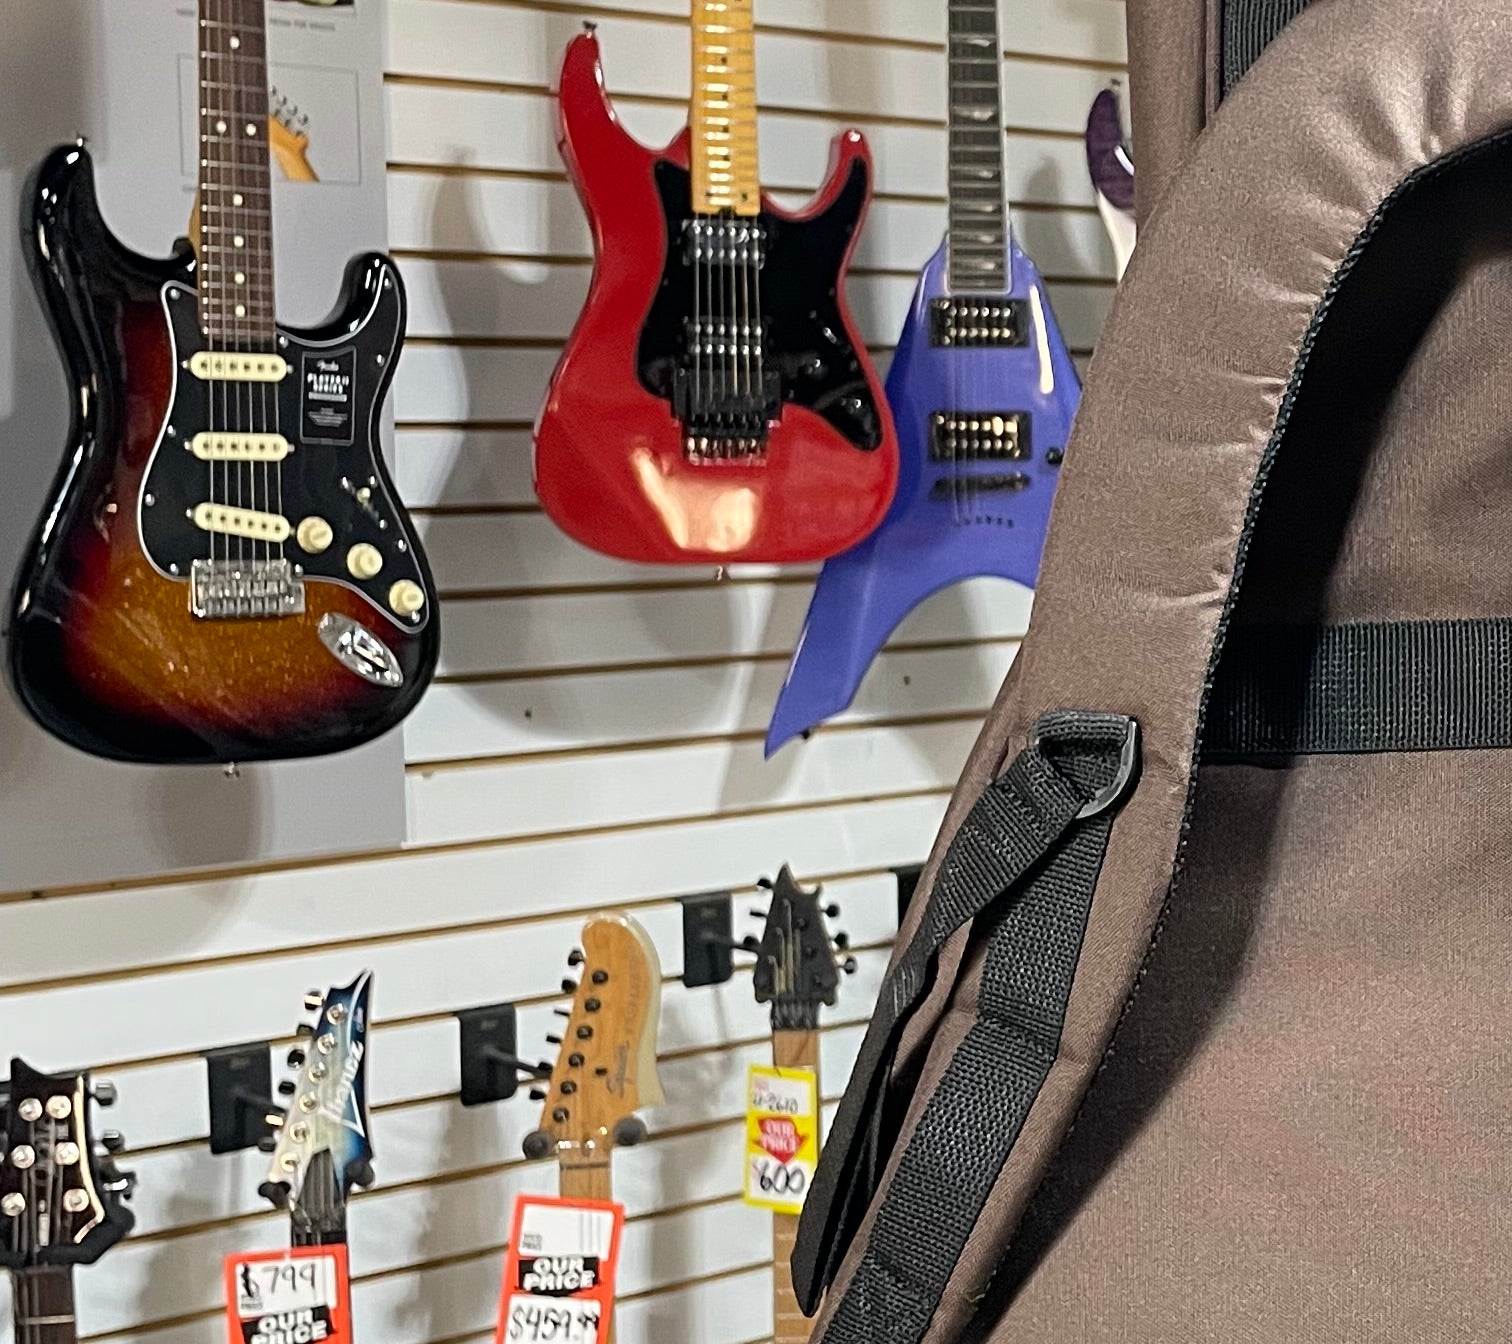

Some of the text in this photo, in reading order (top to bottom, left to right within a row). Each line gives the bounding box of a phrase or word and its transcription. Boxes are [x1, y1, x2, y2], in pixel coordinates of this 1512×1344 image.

[765, 1118, 797, 1137] OUR
[759, 1134, 801, 1152] PRICE
[532, 1256, 585, 1275] OUR
[522, 1270, 596, 1292] PRICE
[257, 1308, 314, 1334] OUR
